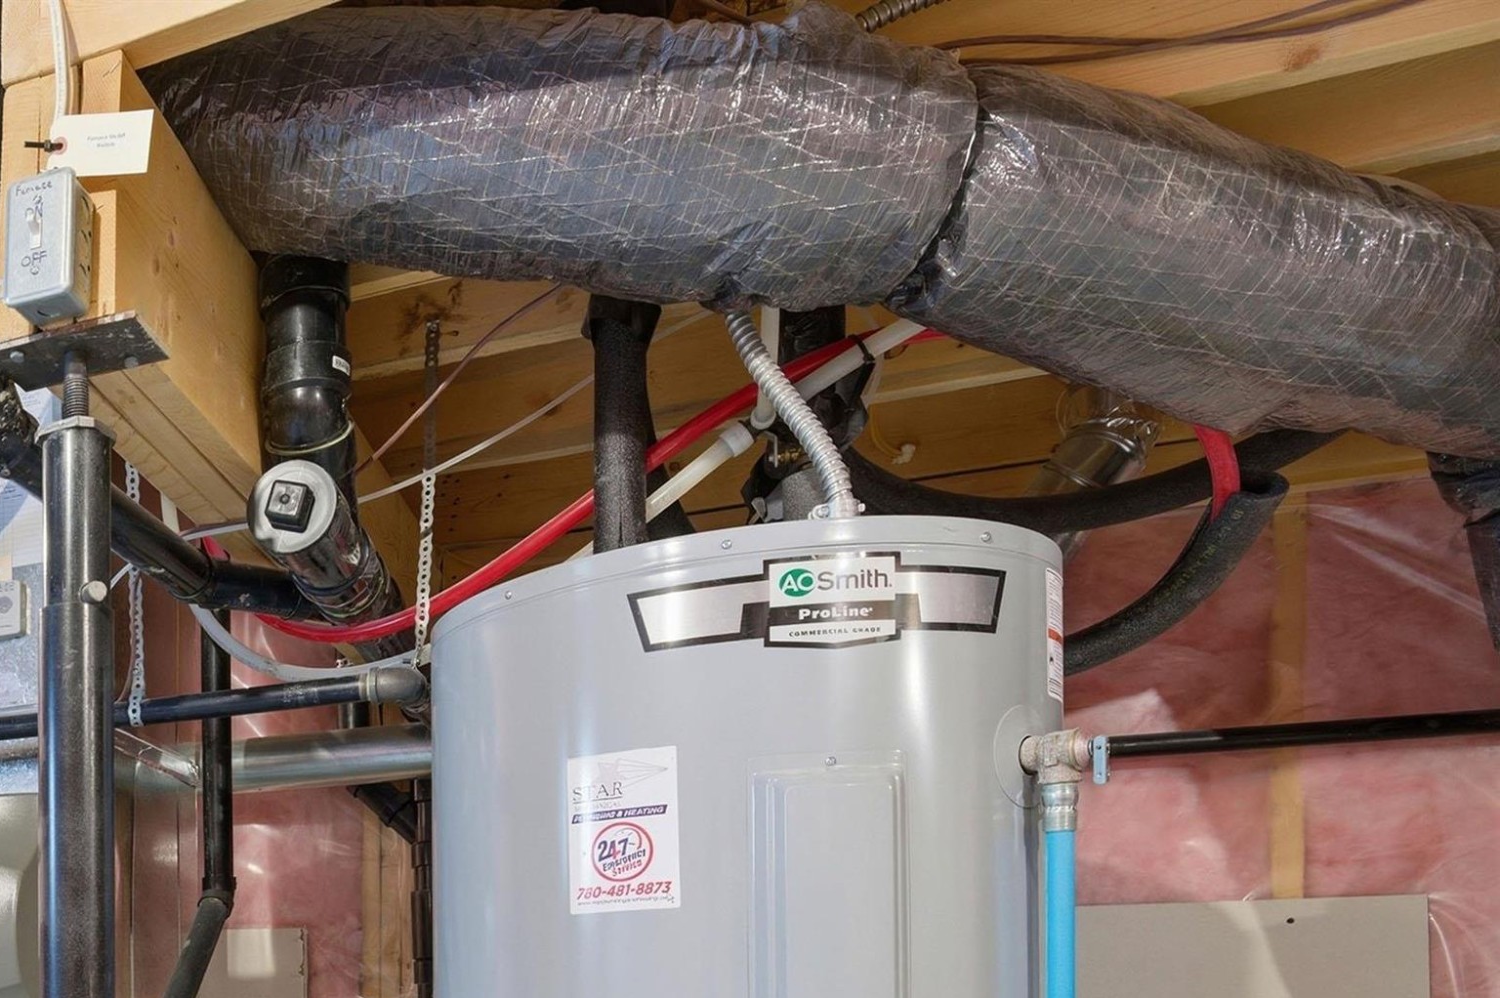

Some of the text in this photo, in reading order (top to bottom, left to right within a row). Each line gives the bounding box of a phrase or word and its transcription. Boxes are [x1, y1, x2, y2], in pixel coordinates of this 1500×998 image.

[20, 250, 47, 268] OFF
[624, 805, 664, 818] HEATING
[577, 881, 672, 900] 780-481-8873
